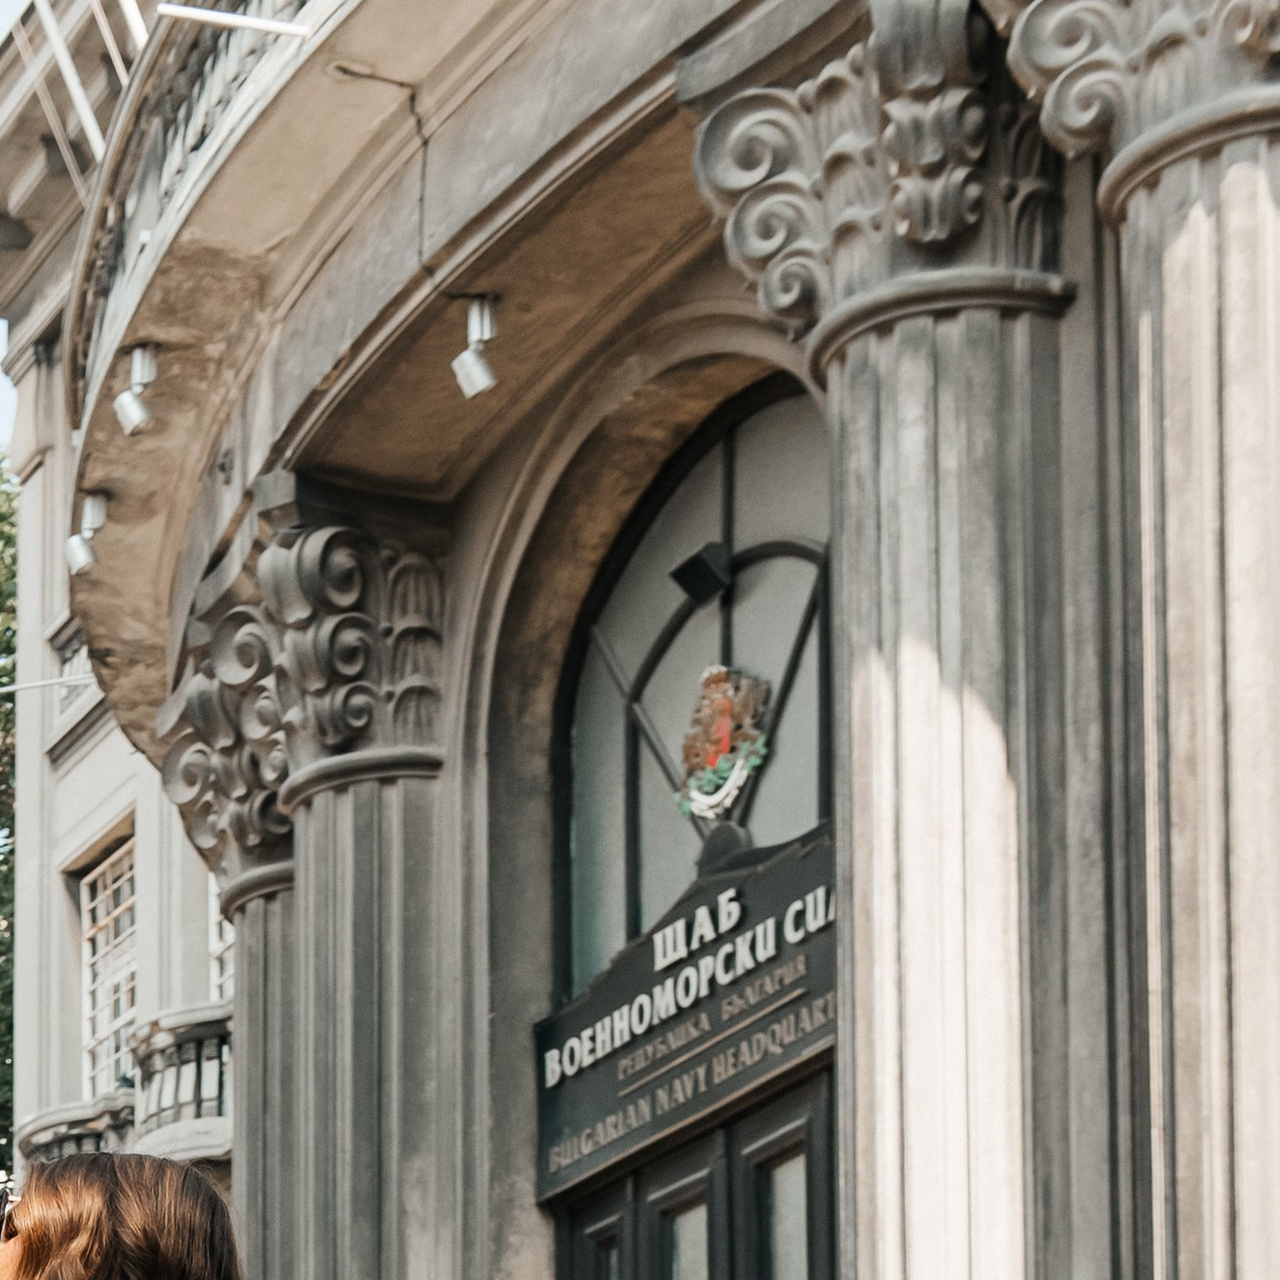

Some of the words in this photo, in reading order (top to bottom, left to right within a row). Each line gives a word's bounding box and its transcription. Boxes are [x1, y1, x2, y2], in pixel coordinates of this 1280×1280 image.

[652, 887, 741, 972] ЩАБ
[544, 917, 776, 1089] ВОЕННОМОРСКИ
[548, 1094, 652, 1174] BULGARIAN
[655, 1062, 707, 1116] NAVY
